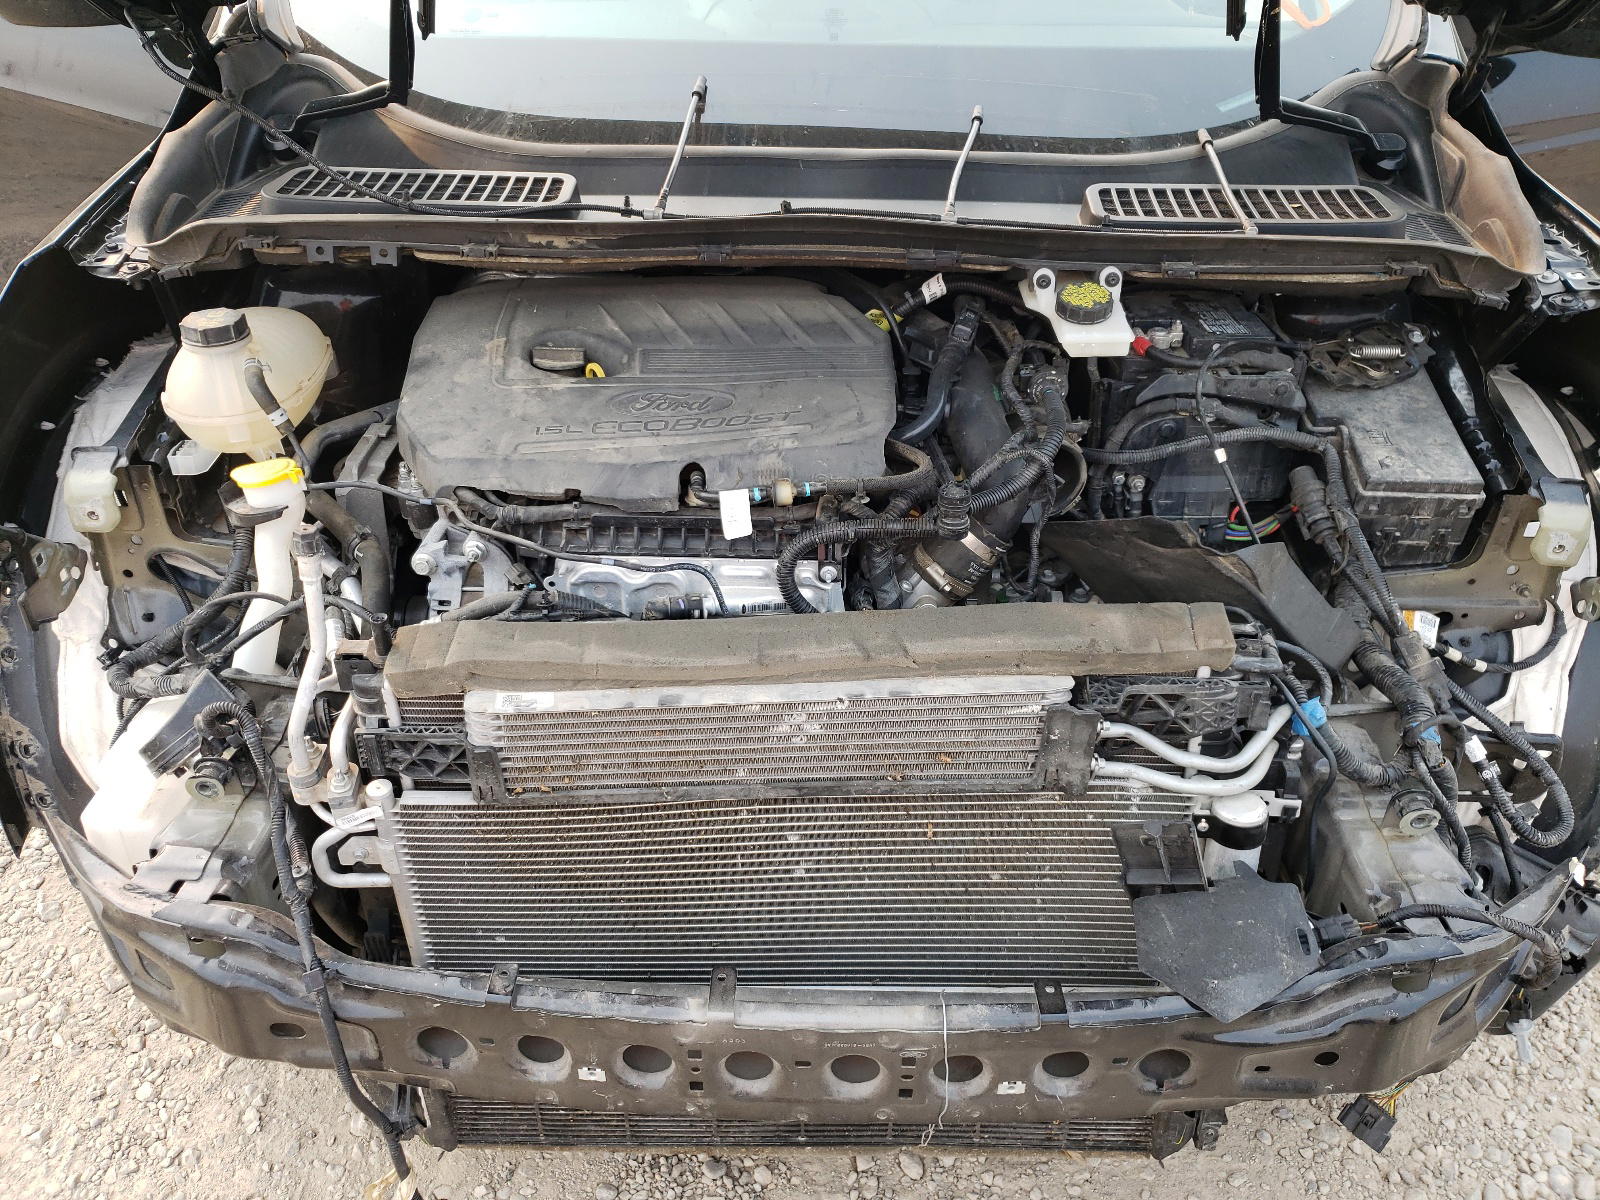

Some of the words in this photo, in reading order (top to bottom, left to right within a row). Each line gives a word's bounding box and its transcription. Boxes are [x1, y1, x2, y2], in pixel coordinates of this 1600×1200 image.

[630, 392, 713, 412] Ford
[535, 424, 583, 436] 1.5L
[591, 410, 802, 435] ECOBOOST
